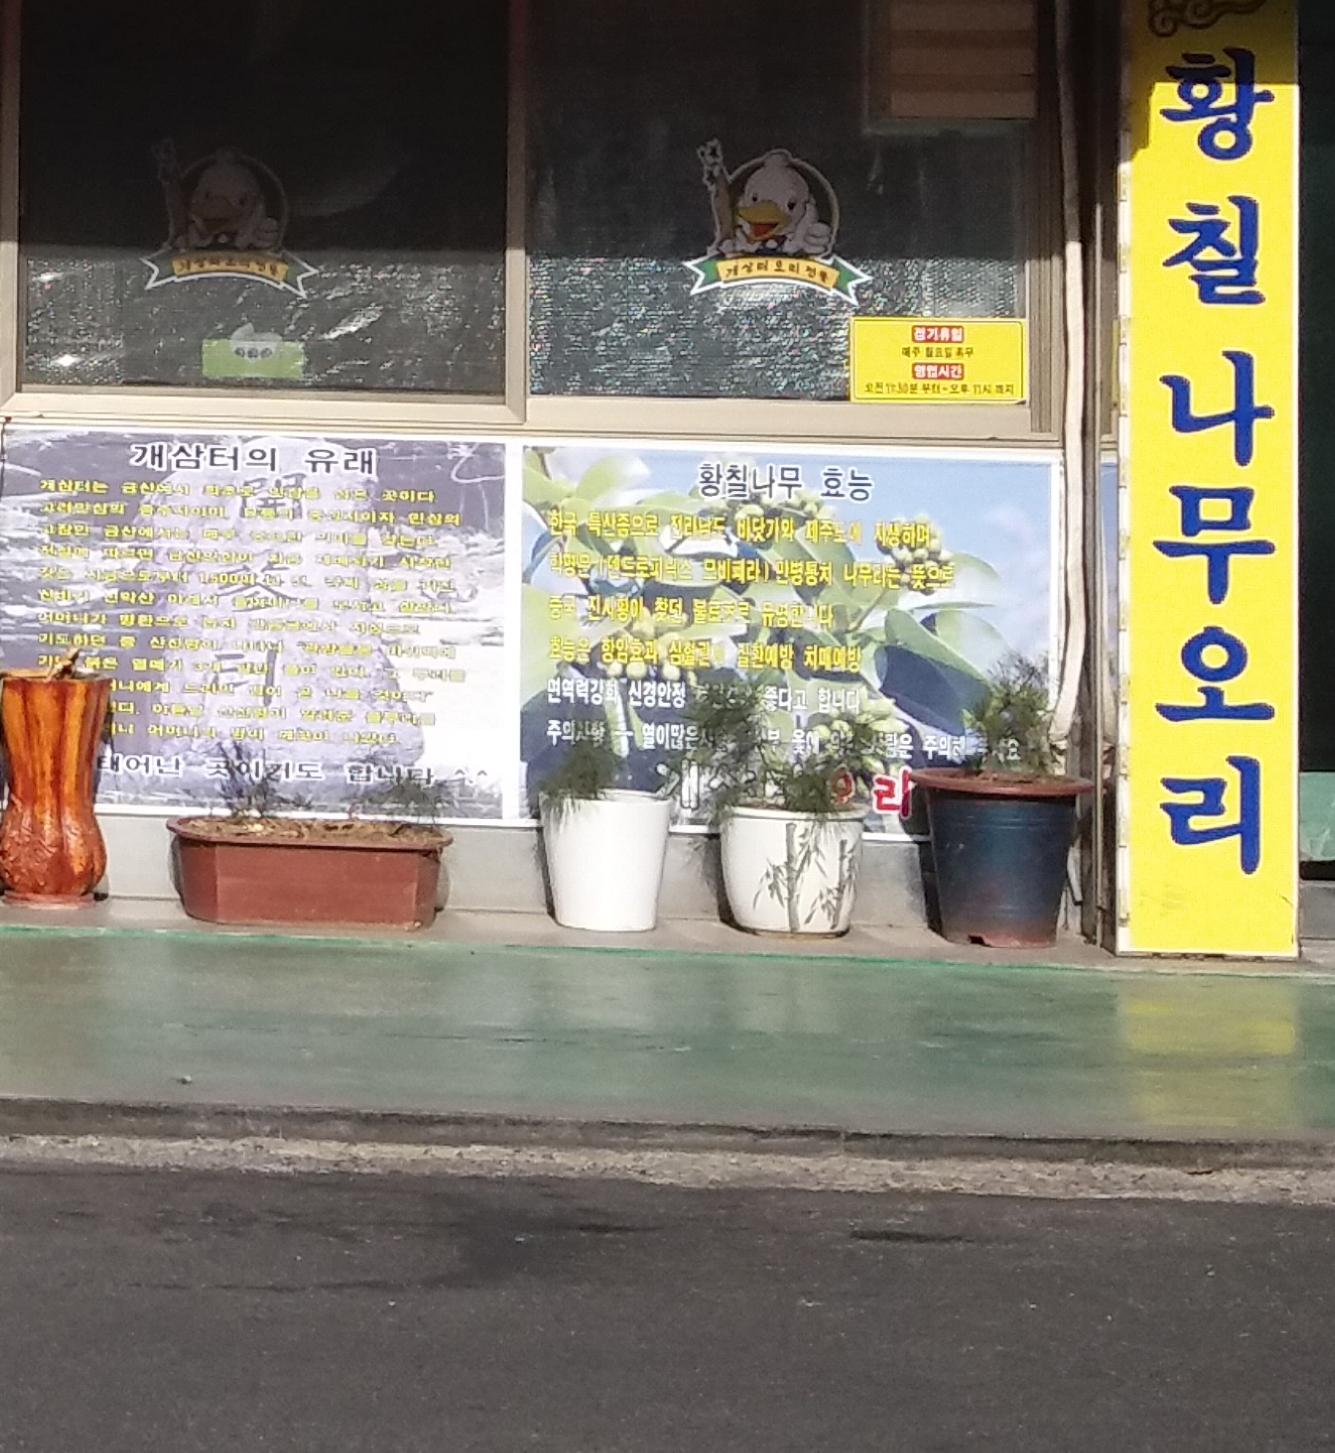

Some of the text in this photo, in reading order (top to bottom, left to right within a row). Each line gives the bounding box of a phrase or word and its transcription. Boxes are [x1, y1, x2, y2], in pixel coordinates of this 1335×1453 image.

[913, 363, 963, 379] 영업시간
[130, 442, 378, 477] 개삼터의 유래
[1152, 46, 1276, 876] 황칠나무오리
[698, 461, 876, 503] 황칠나무 효능
[549, 508, 578, 537] 한국
[549, 595, 577, 621] 중국
[587, 595, 644, 623] 진시황이
[628, 679, 687, 709] 신경안정
[97, 752, 185, 778] 태어난
